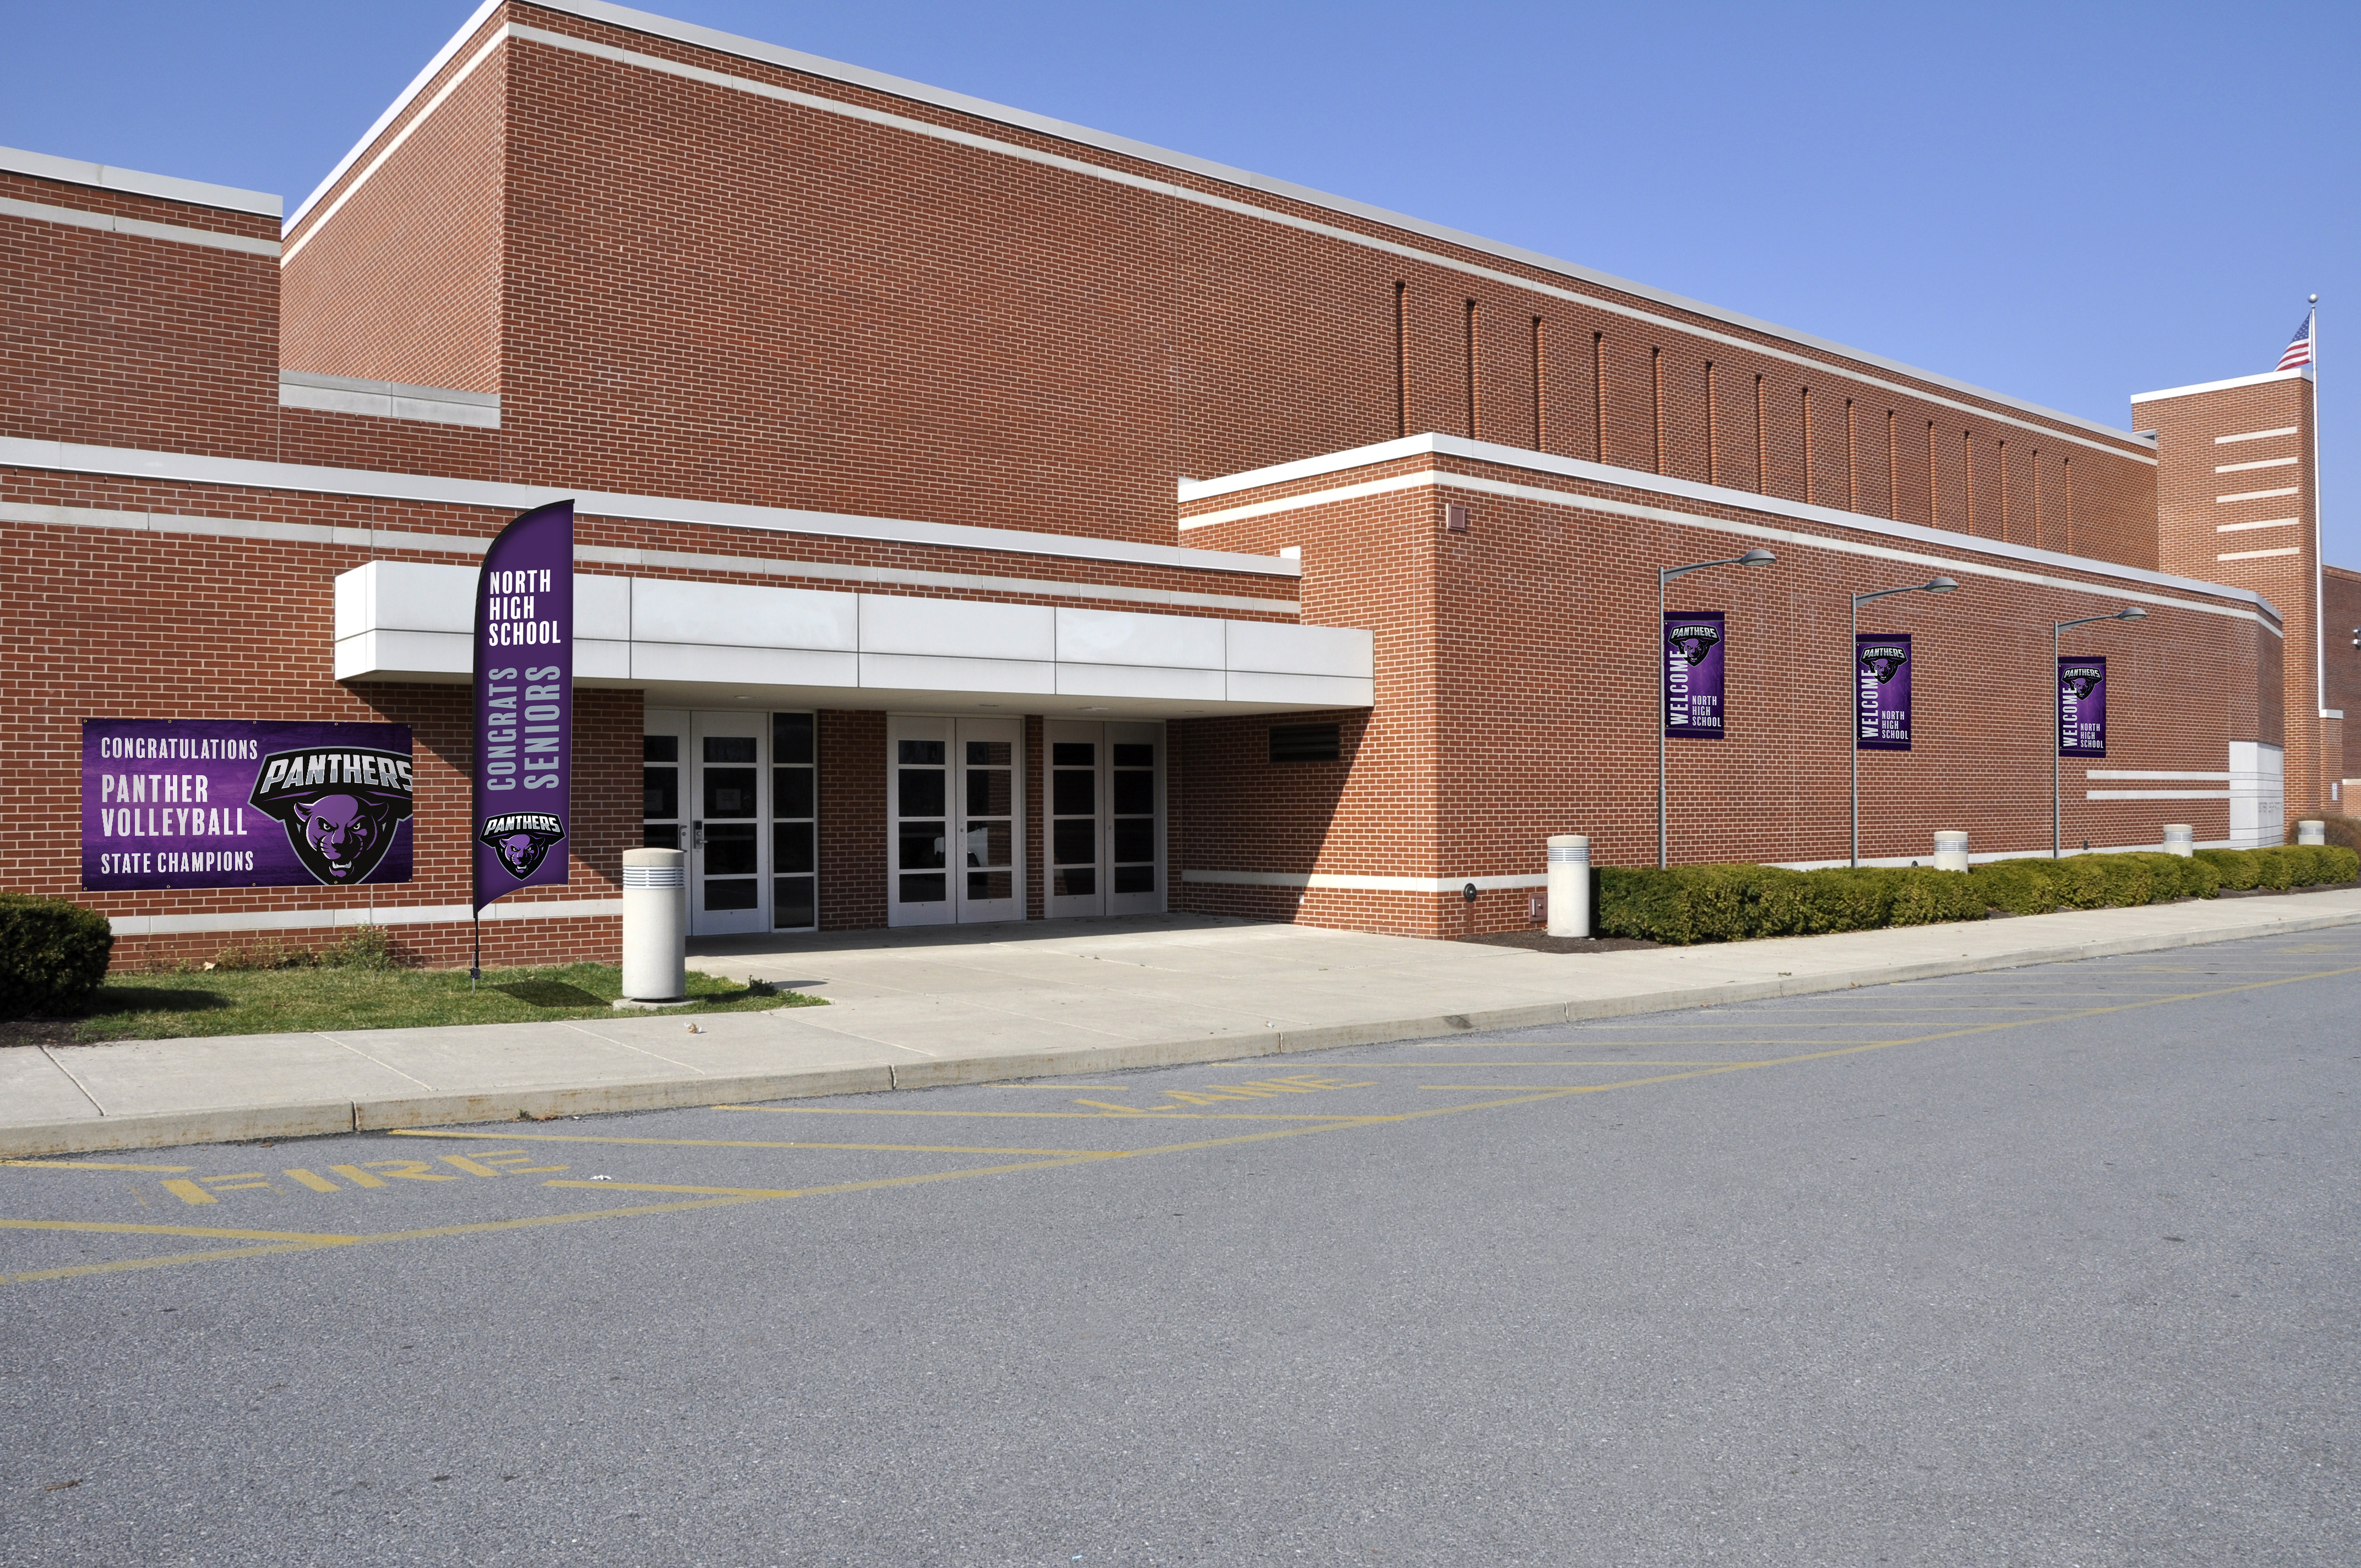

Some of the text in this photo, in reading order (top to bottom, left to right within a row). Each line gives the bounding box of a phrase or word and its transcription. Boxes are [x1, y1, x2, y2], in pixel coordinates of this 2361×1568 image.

[490, 569, 551, 594] NORTH
[489, 596, 534, 620] HIGH
[489, 621, 561, 646] SCHOOL
[1671, 627, 1717, 639] PANTHERS
[1863, 648, 1905, 658] PANTHERS
[2064, 668, 2101, 678] PANTHERS
[1670, 650, 1689, 725] WELCOME
[1692, 695, 1717, 706] NORTH
[1692, 706, 1711, 716] HIGH
[1861, 669, 1879, 738] WELCOME
[1692, 716, 1721, 727] SCHOOL
[1881, 711, 1905, 720] NORTH
[1882, 720, 1898, 729] HIGH
[2063, 688, 2077, 747] WELCOME
[487, 667, 518, 791] CONGRATS
[524, 666, 561, 789] SENIORS
[1882, 730, 1908, 739] SCHOOL
[101, 737, 258, 759] CONGRATULATIONS
[2080, 740, 2103, 748] SCHOOL
[260, 754, 412, 794] PANTHERS
[102, 775, 208, 802] PANTHER
[101, 808, 247, 836] VOLLEYBALL
[484, 815, 561, 836] PANTHERS
[101, 851, 253, 874] STATE CHAMPIONS
[161, 1150, 570, 1205] FIRE
